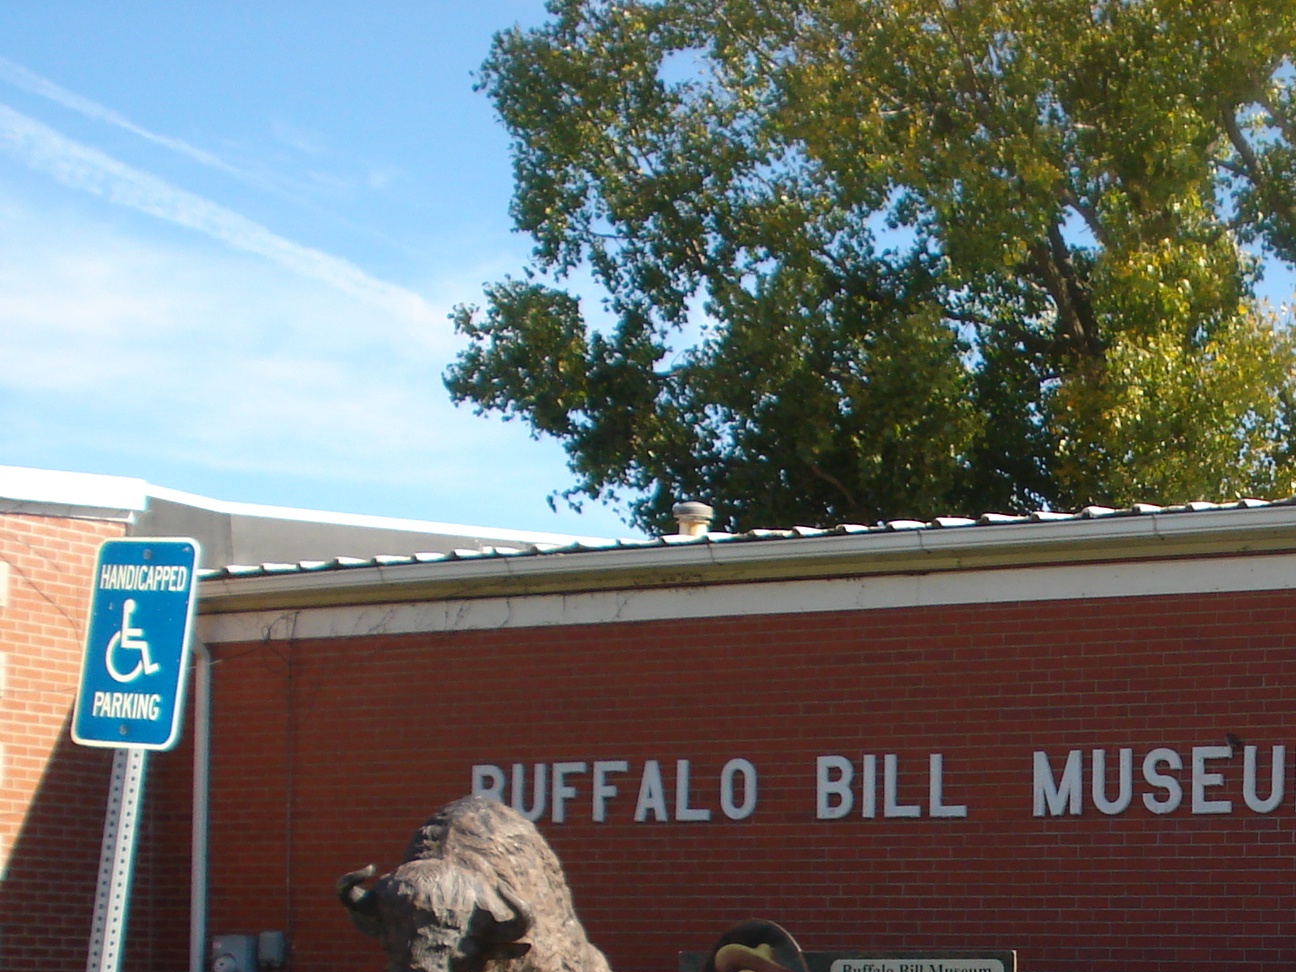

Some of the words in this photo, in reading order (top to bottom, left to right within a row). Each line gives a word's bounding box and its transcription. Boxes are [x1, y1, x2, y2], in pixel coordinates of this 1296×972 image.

[99, 564, 187, 592] HANDICAPPED
[92, 691, 161, 721] PARKING
[471, 758, 758, 824] BUFFALO
[816, 753, 969, 821] BILL
